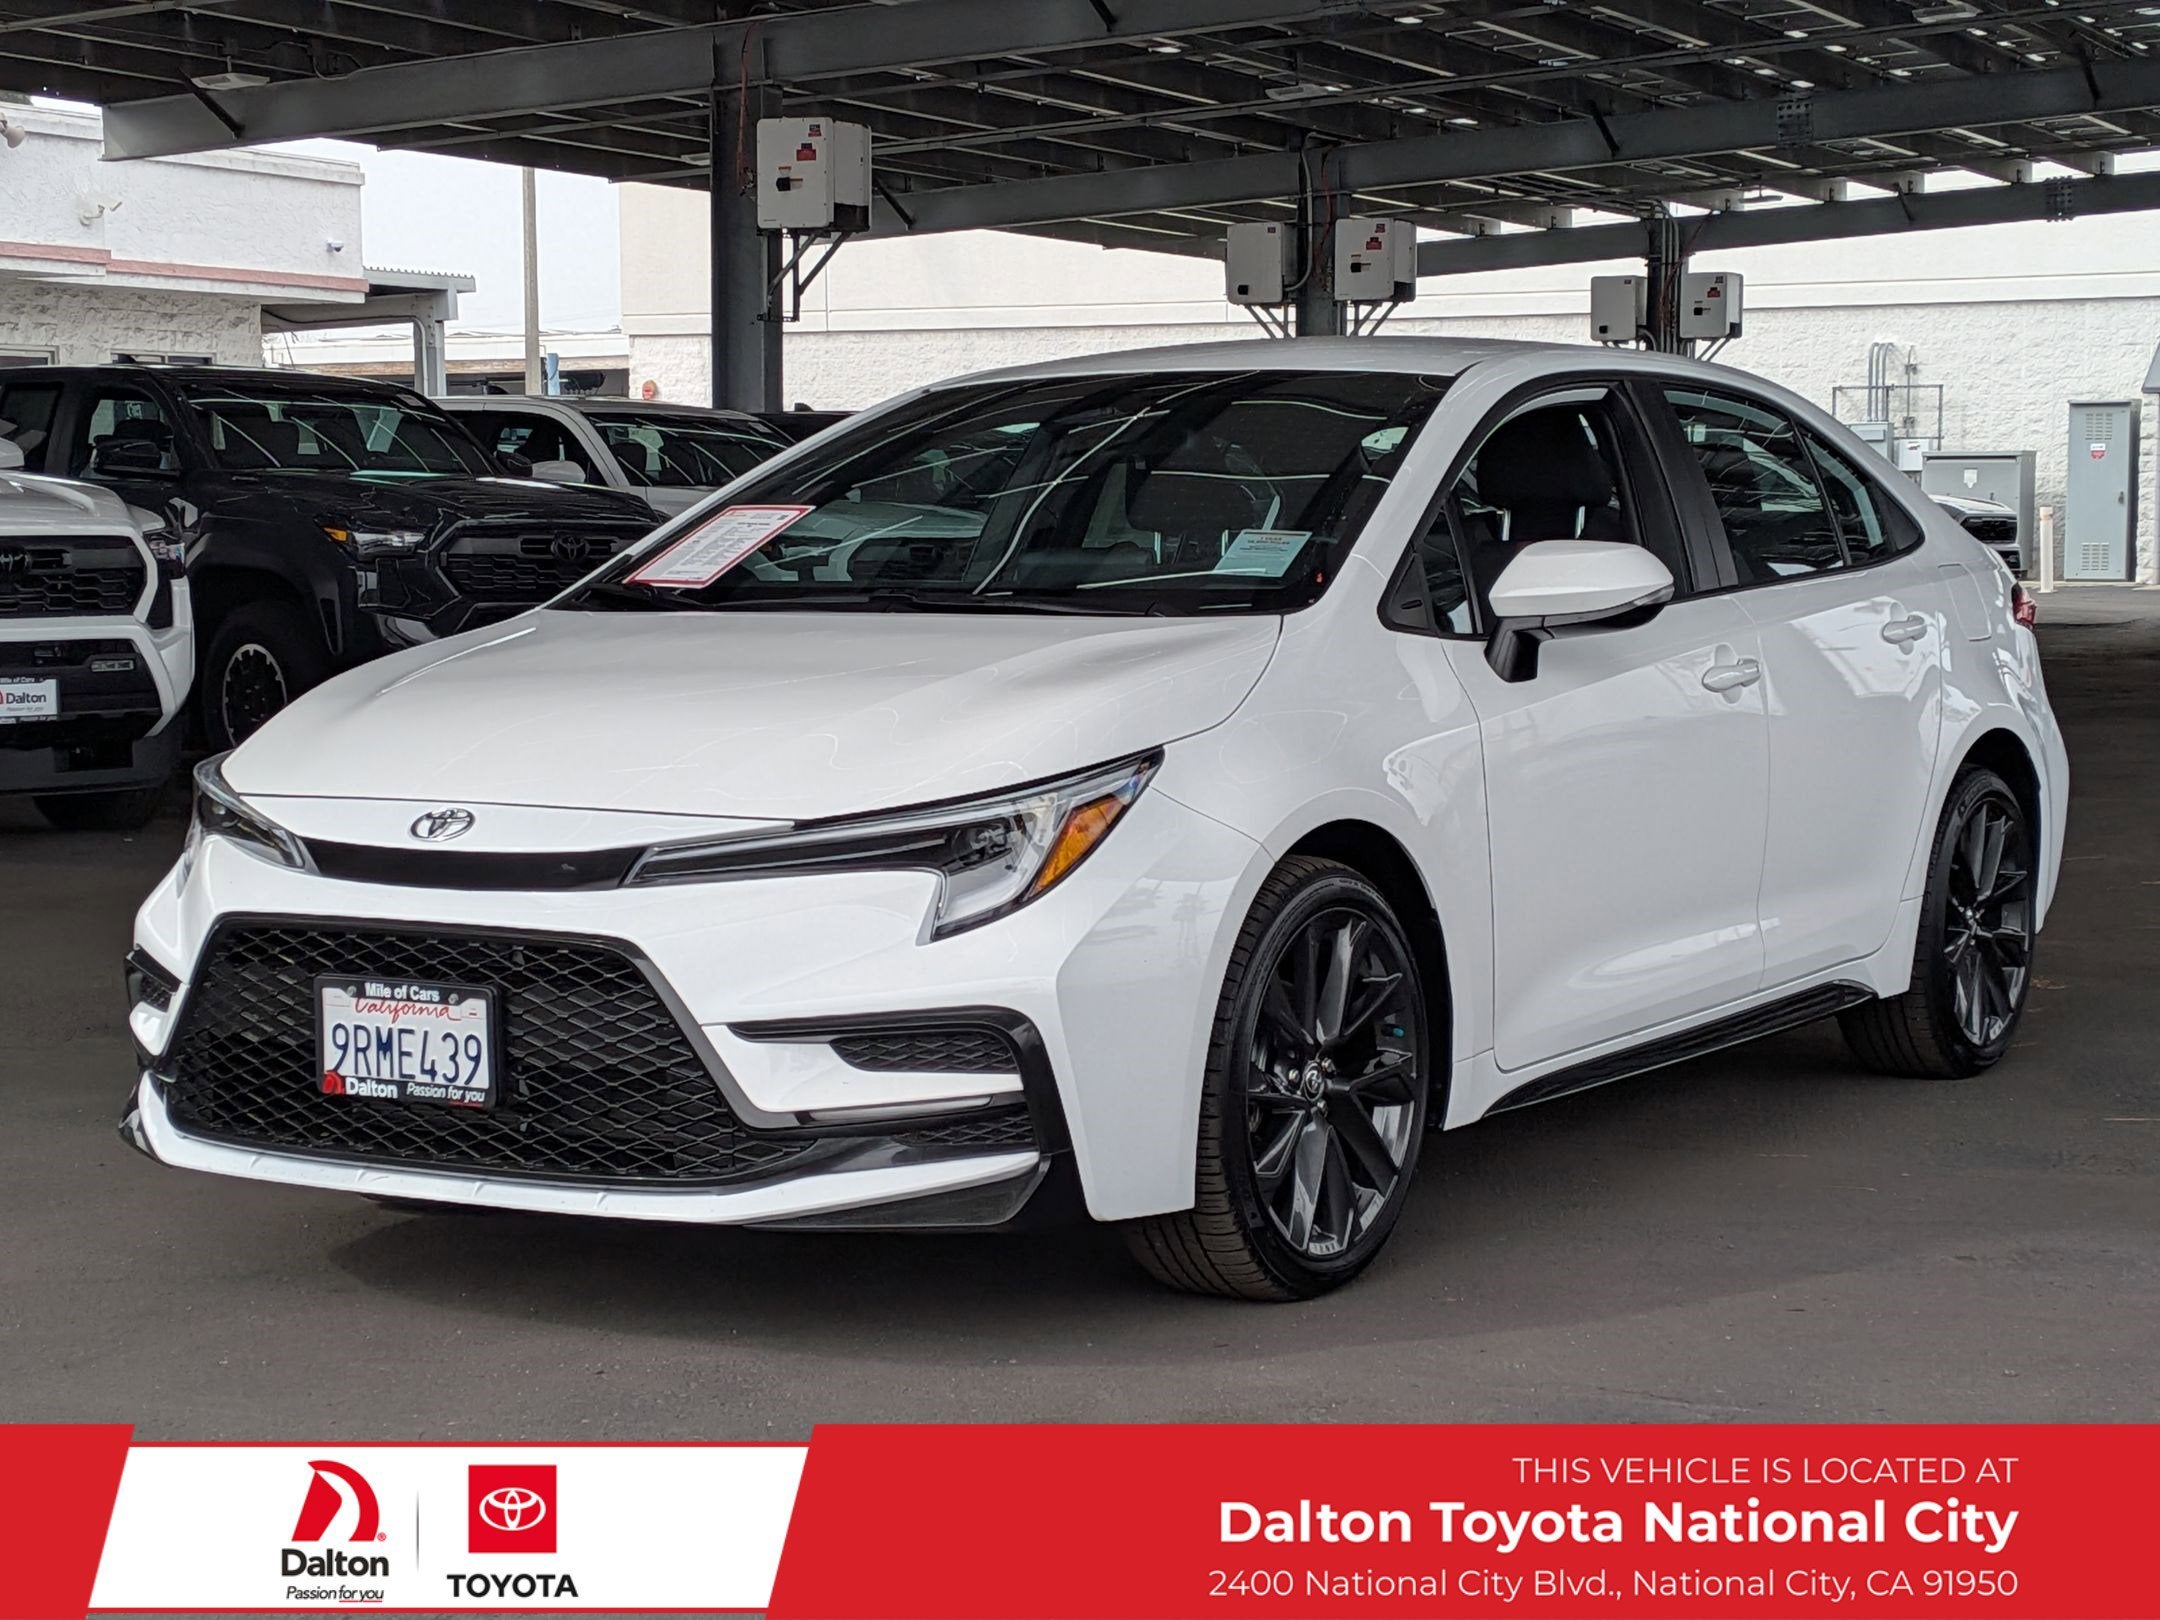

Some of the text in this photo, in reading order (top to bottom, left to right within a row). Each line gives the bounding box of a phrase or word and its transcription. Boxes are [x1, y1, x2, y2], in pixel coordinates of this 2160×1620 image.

[6, 692, 47, 704] Dalton
[364, 982, 440, 1002] Mile of Cars
[332, 1023, 482, 1085] 9RME439
[345, 1077, 485, 1103] Dalton Passion for you
